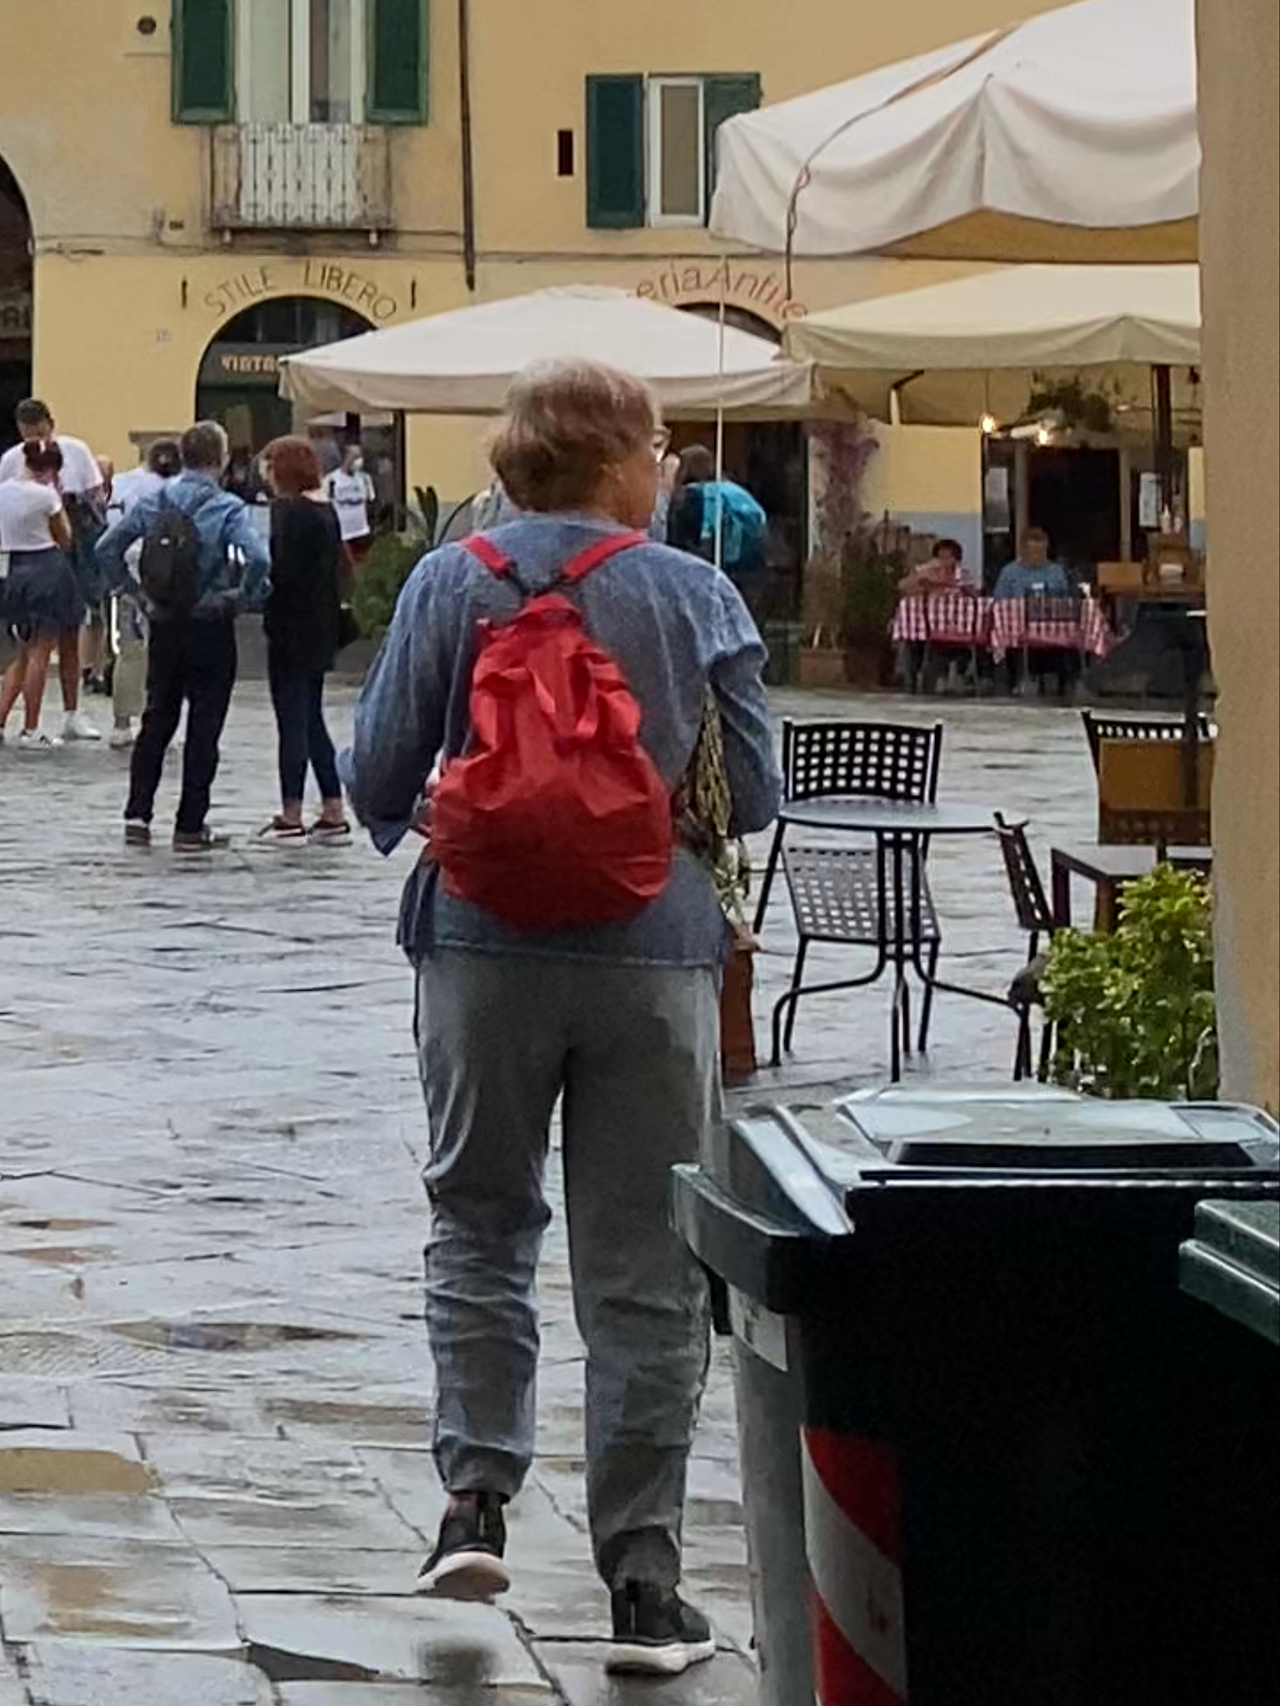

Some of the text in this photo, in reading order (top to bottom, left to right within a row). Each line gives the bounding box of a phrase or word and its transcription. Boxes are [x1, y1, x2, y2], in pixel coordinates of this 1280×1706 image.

[204, 259, 397, 321] STILE LIBERO
[220, 352, 277, 374] VINTA
